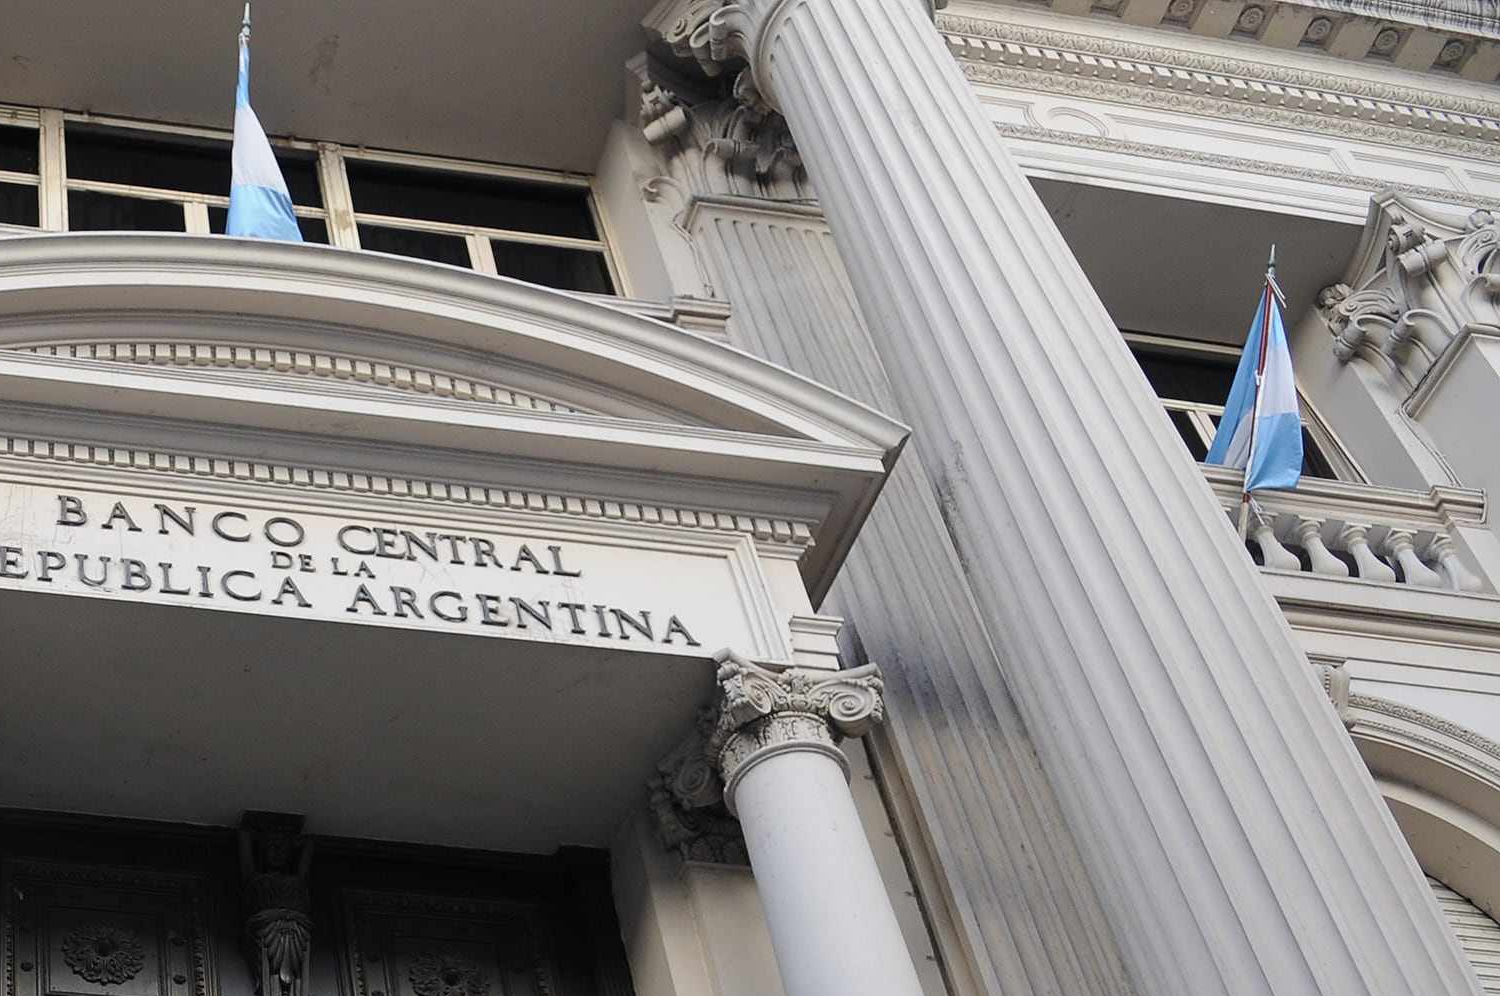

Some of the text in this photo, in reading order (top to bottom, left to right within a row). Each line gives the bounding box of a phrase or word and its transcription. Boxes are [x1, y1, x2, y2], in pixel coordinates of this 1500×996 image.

[56, 493, 582, 577] BANCO CENTRAL
[270, 550, 376, 579] DE LA
[346, 582, 701, 647] ARGENTINA
